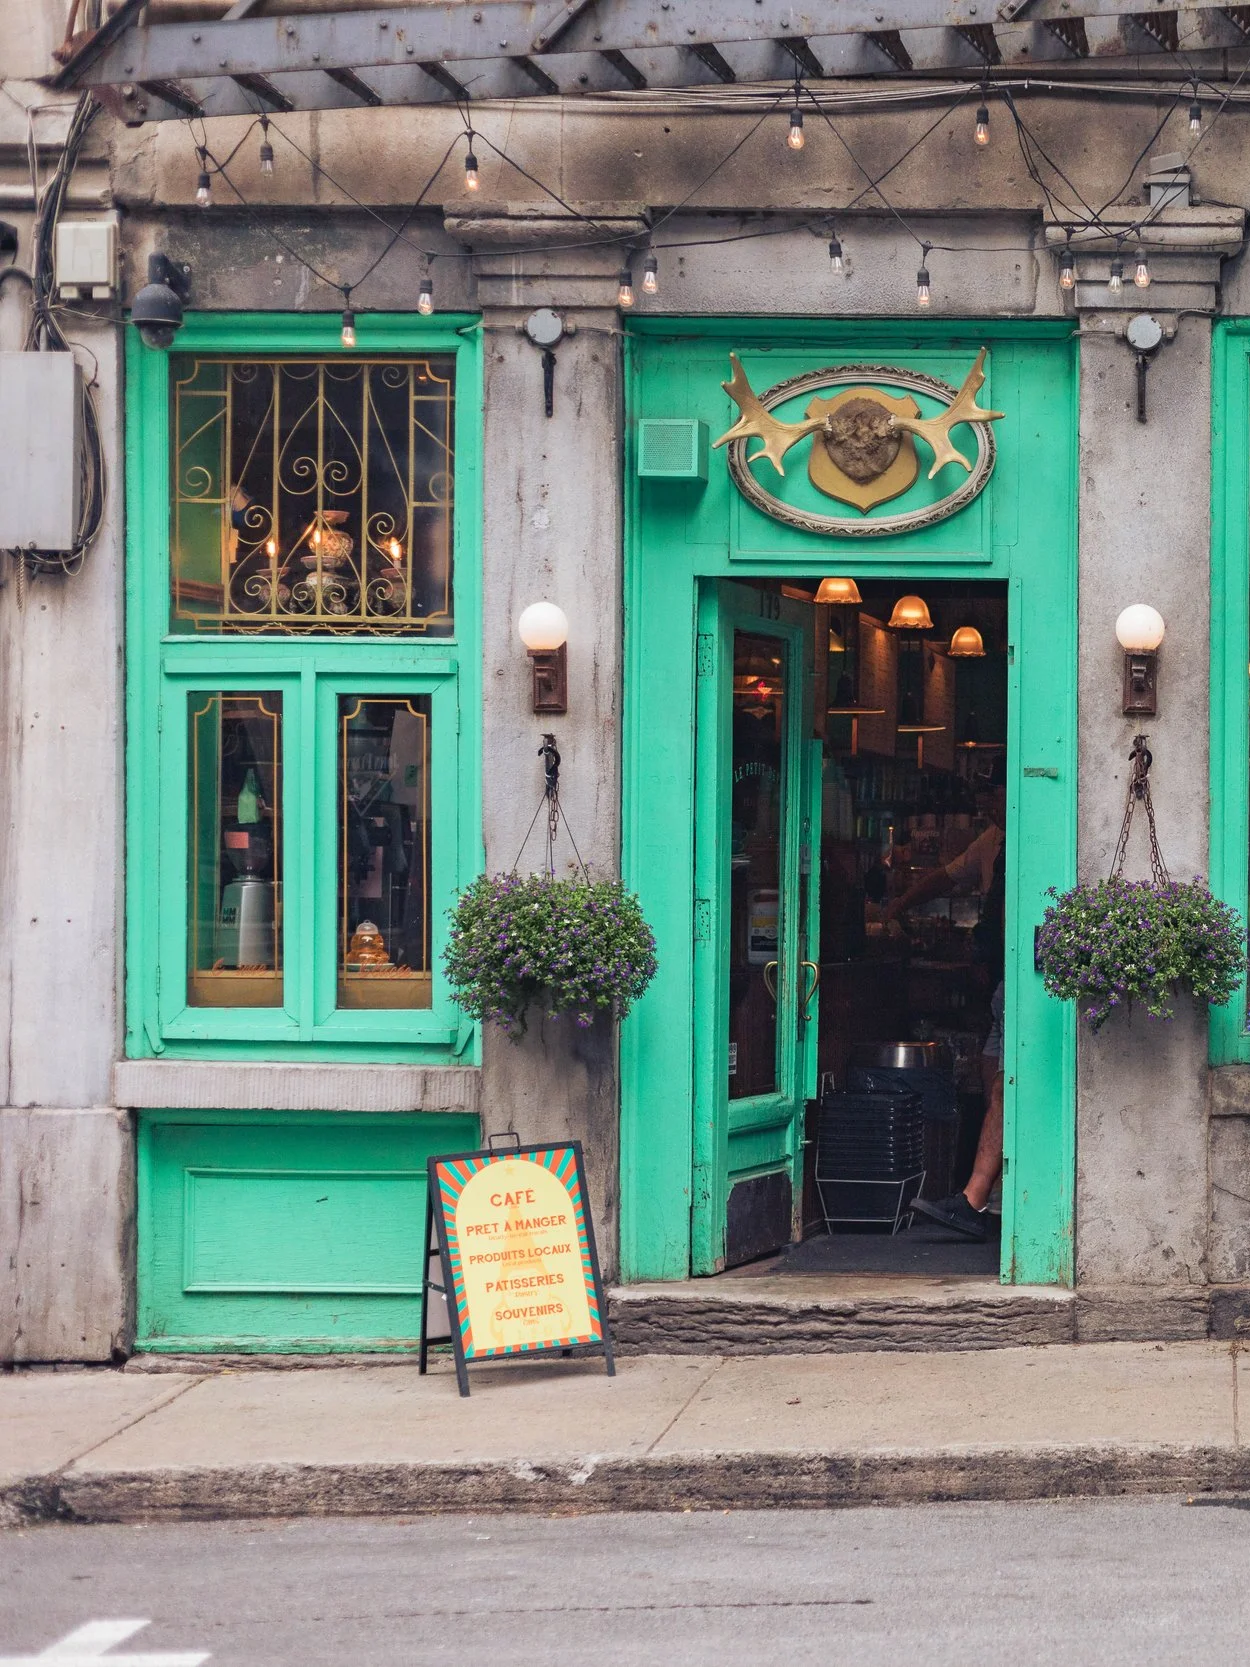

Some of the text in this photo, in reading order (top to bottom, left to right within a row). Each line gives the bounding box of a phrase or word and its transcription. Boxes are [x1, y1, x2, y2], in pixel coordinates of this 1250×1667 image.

[490, 1188, 535, 1207] CAFÉ
[466, 1222, 499, 1236] PRET
[515, 1215, 567, 1231] MANGER
[469, 1244, 571, 1265] PRODUITS LOCAUX
[485, 1273, 564, 1293] PATISSERIES
[495, 1303, 563, 1321] SOUVENIRS
